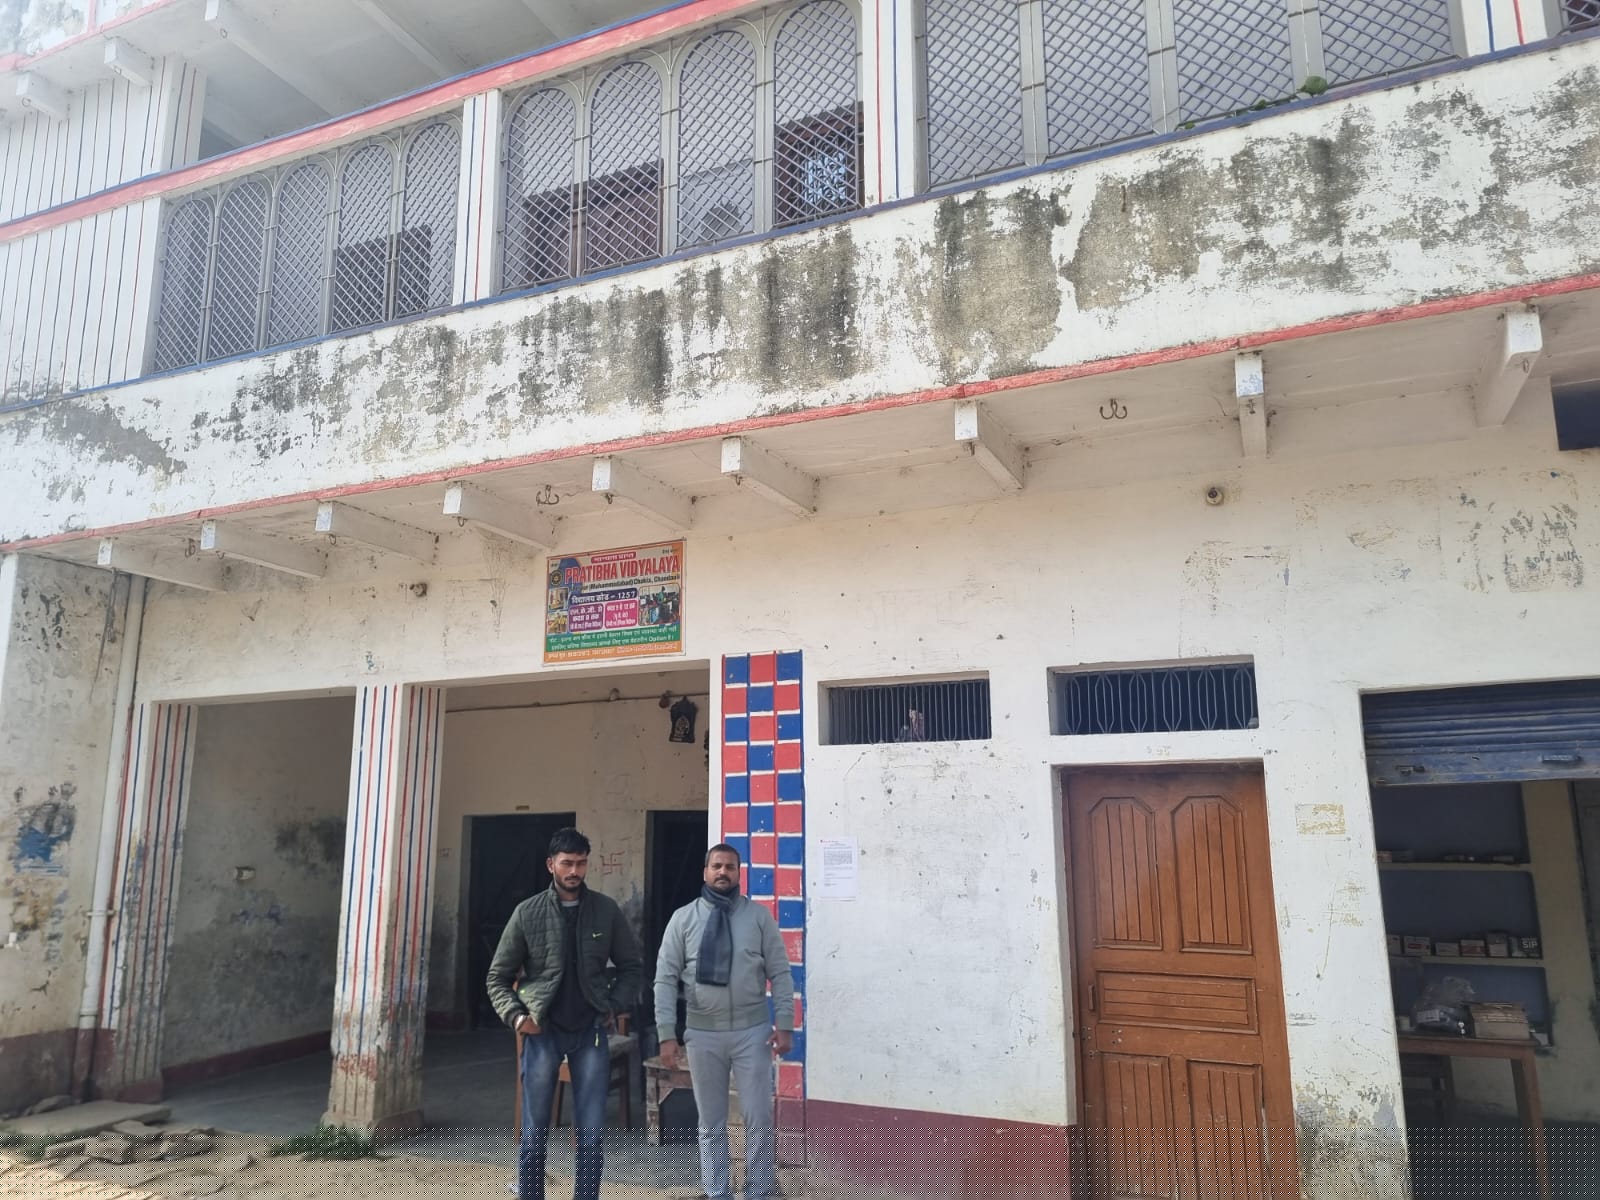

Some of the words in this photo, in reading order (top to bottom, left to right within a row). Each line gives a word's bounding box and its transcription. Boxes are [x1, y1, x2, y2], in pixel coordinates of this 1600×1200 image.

[565, 560, 617, 584] PRATIBHA
[620, 555, 680, 578] VIDYALAYA
[617, 591, 636, 599] 1257
